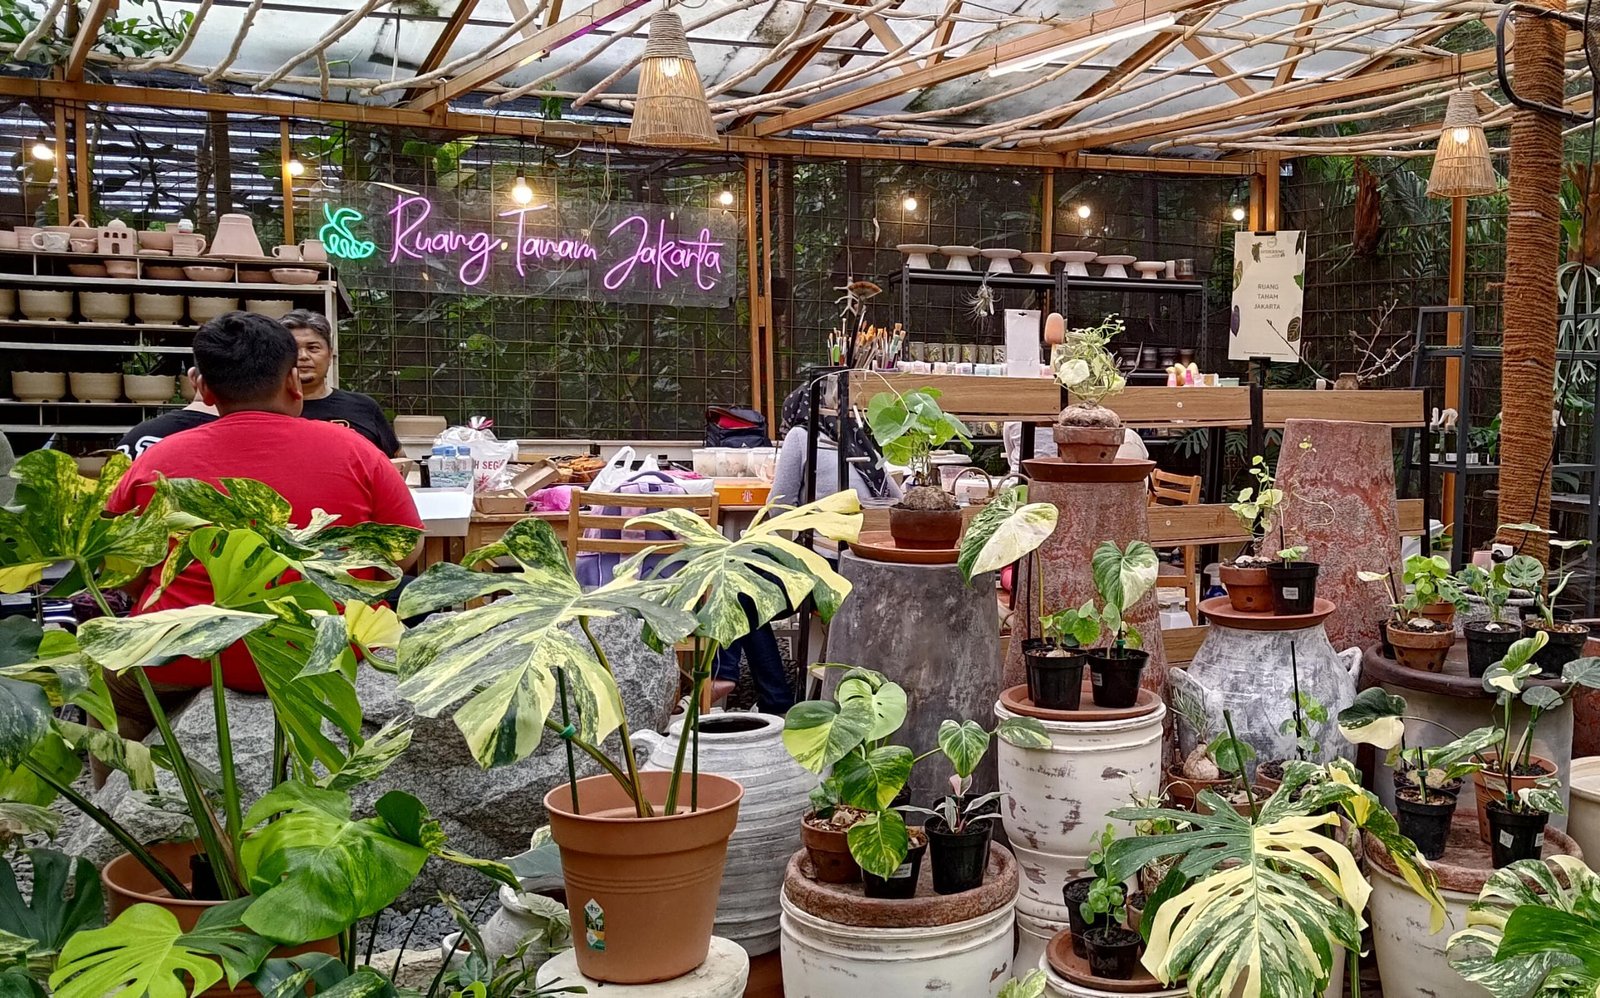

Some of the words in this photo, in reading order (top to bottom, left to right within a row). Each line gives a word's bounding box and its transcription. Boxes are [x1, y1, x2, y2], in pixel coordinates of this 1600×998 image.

[388, 195, 500, 287] Ruang
[500, 204, 597, 278] Tanam
[603, 215, 724, 291] Jakarta
